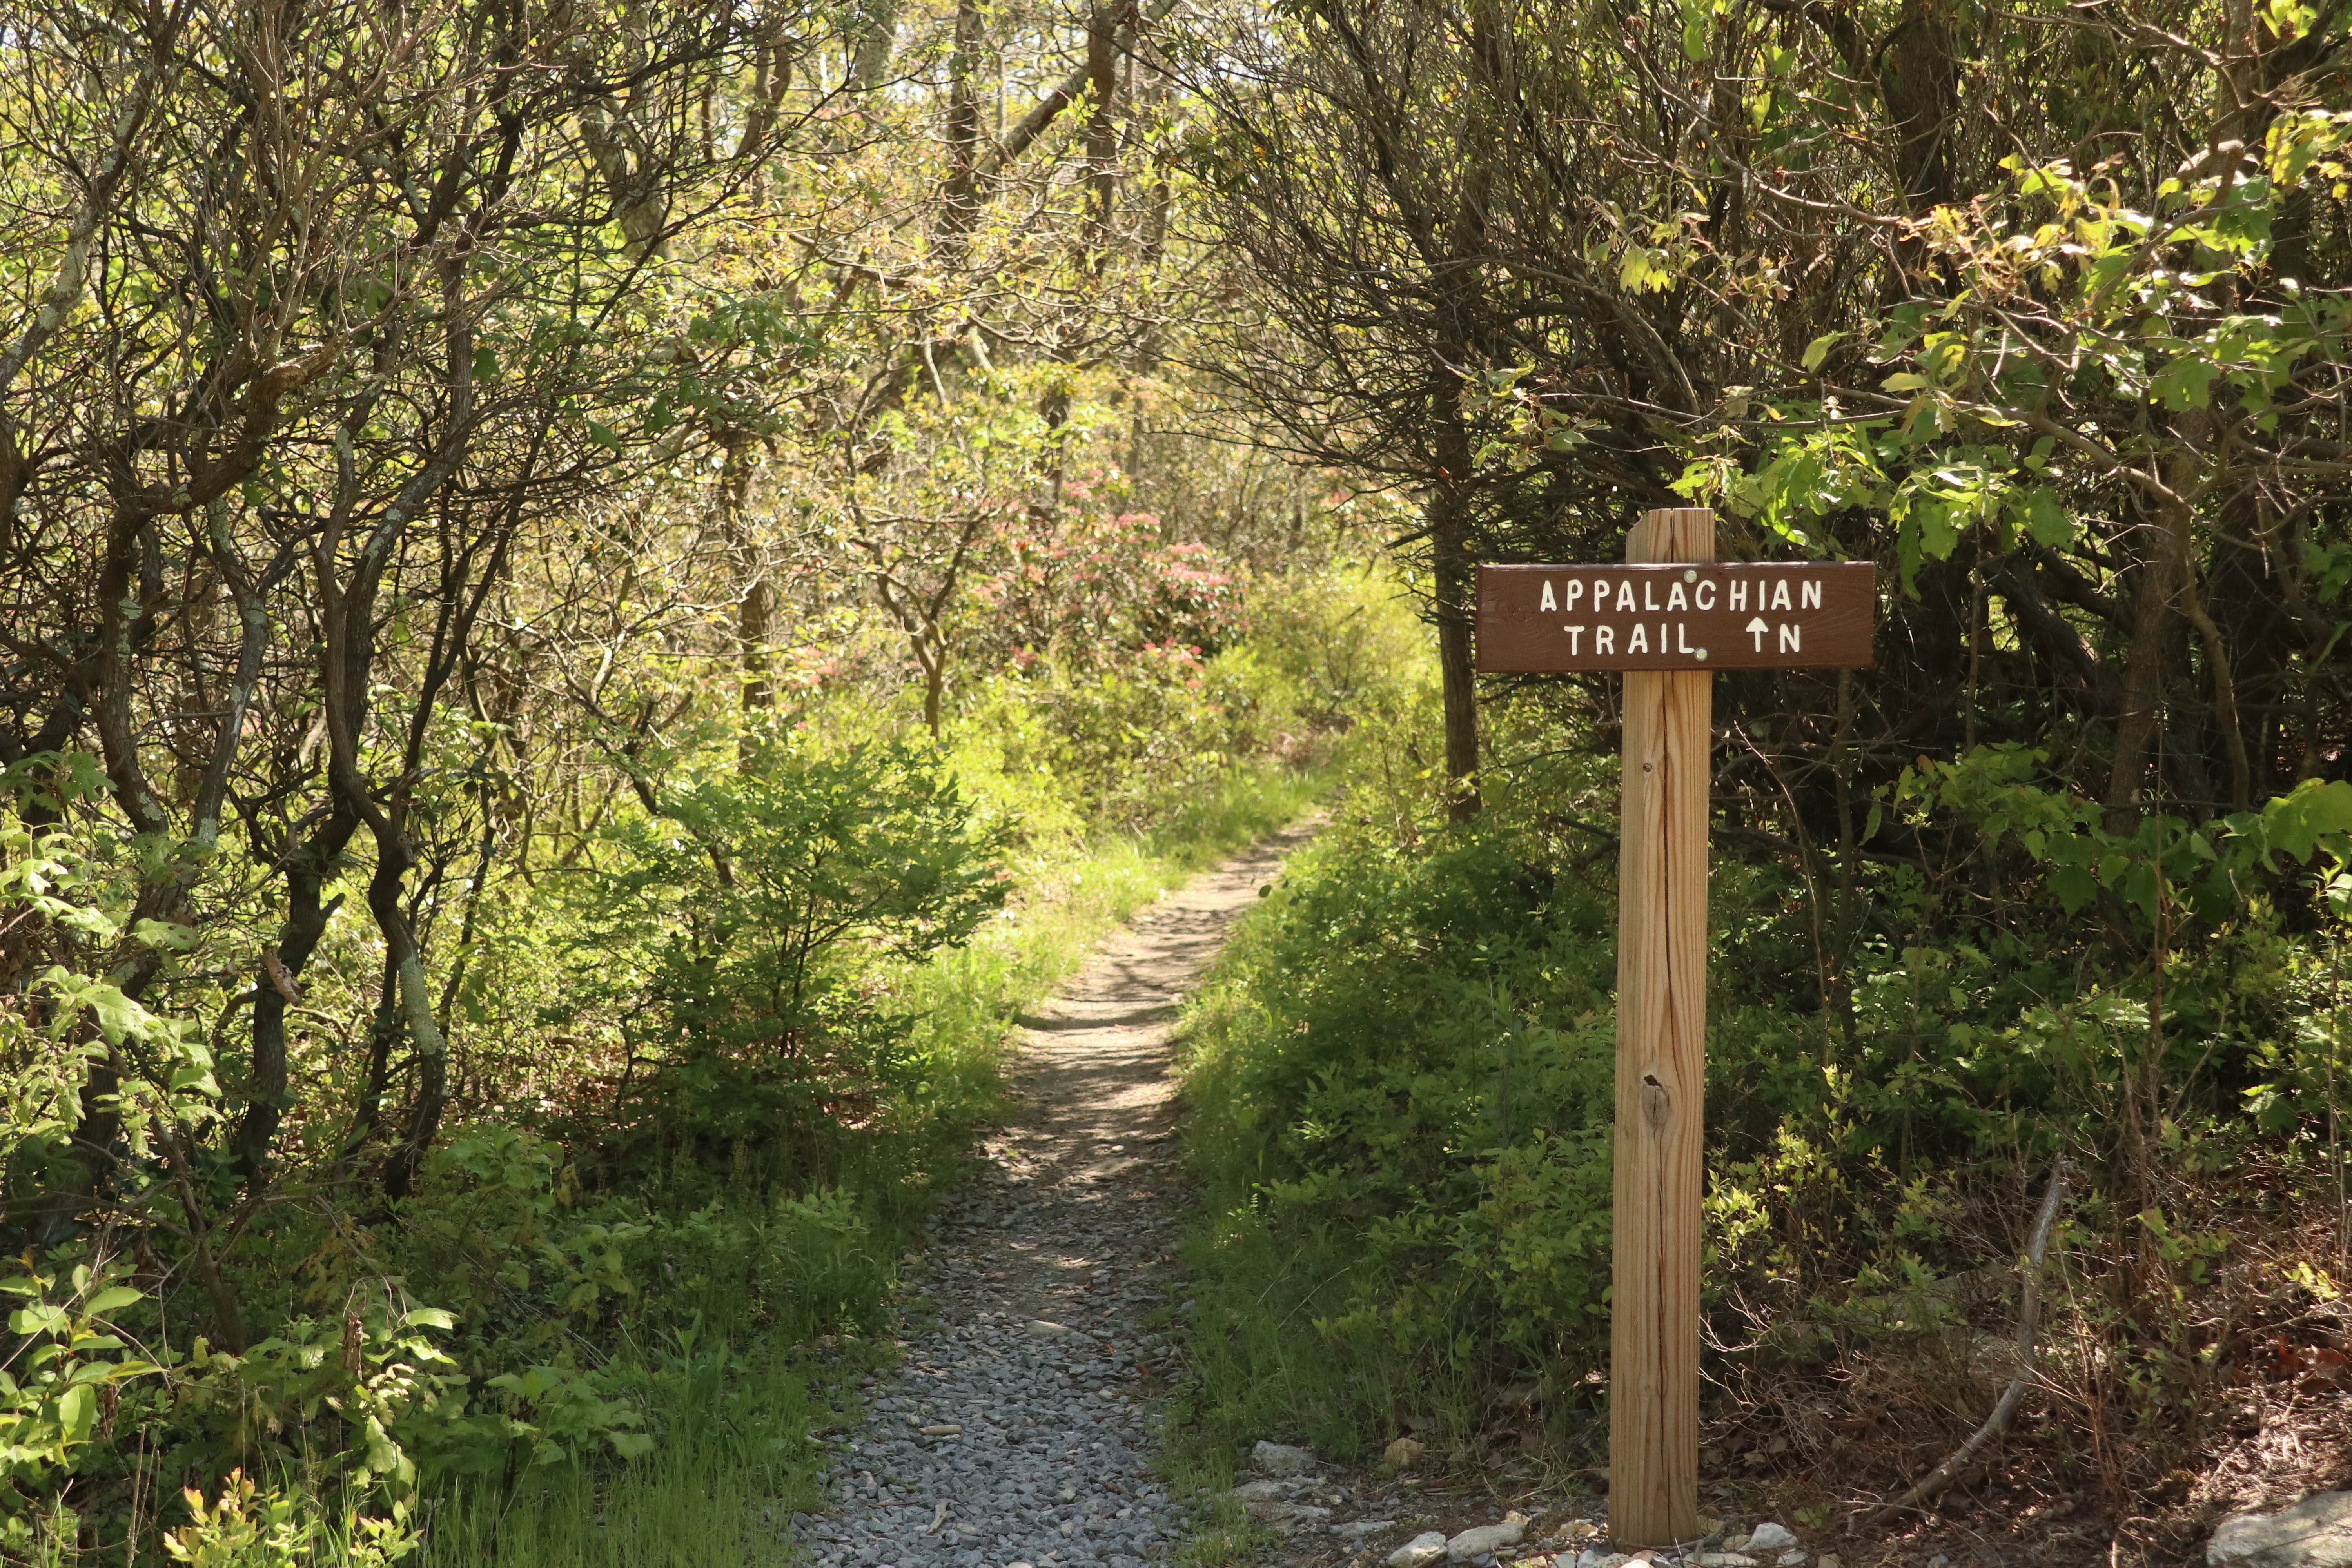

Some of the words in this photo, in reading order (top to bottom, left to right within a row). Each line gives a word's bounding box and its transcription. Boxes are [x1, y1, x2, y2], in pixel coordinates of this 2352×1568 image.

[1540, 579, 1821, 612] APPALACHIAN
[1563, 623, 1695, 656] TRAIL
[1779, 623, 1800, 654] N
